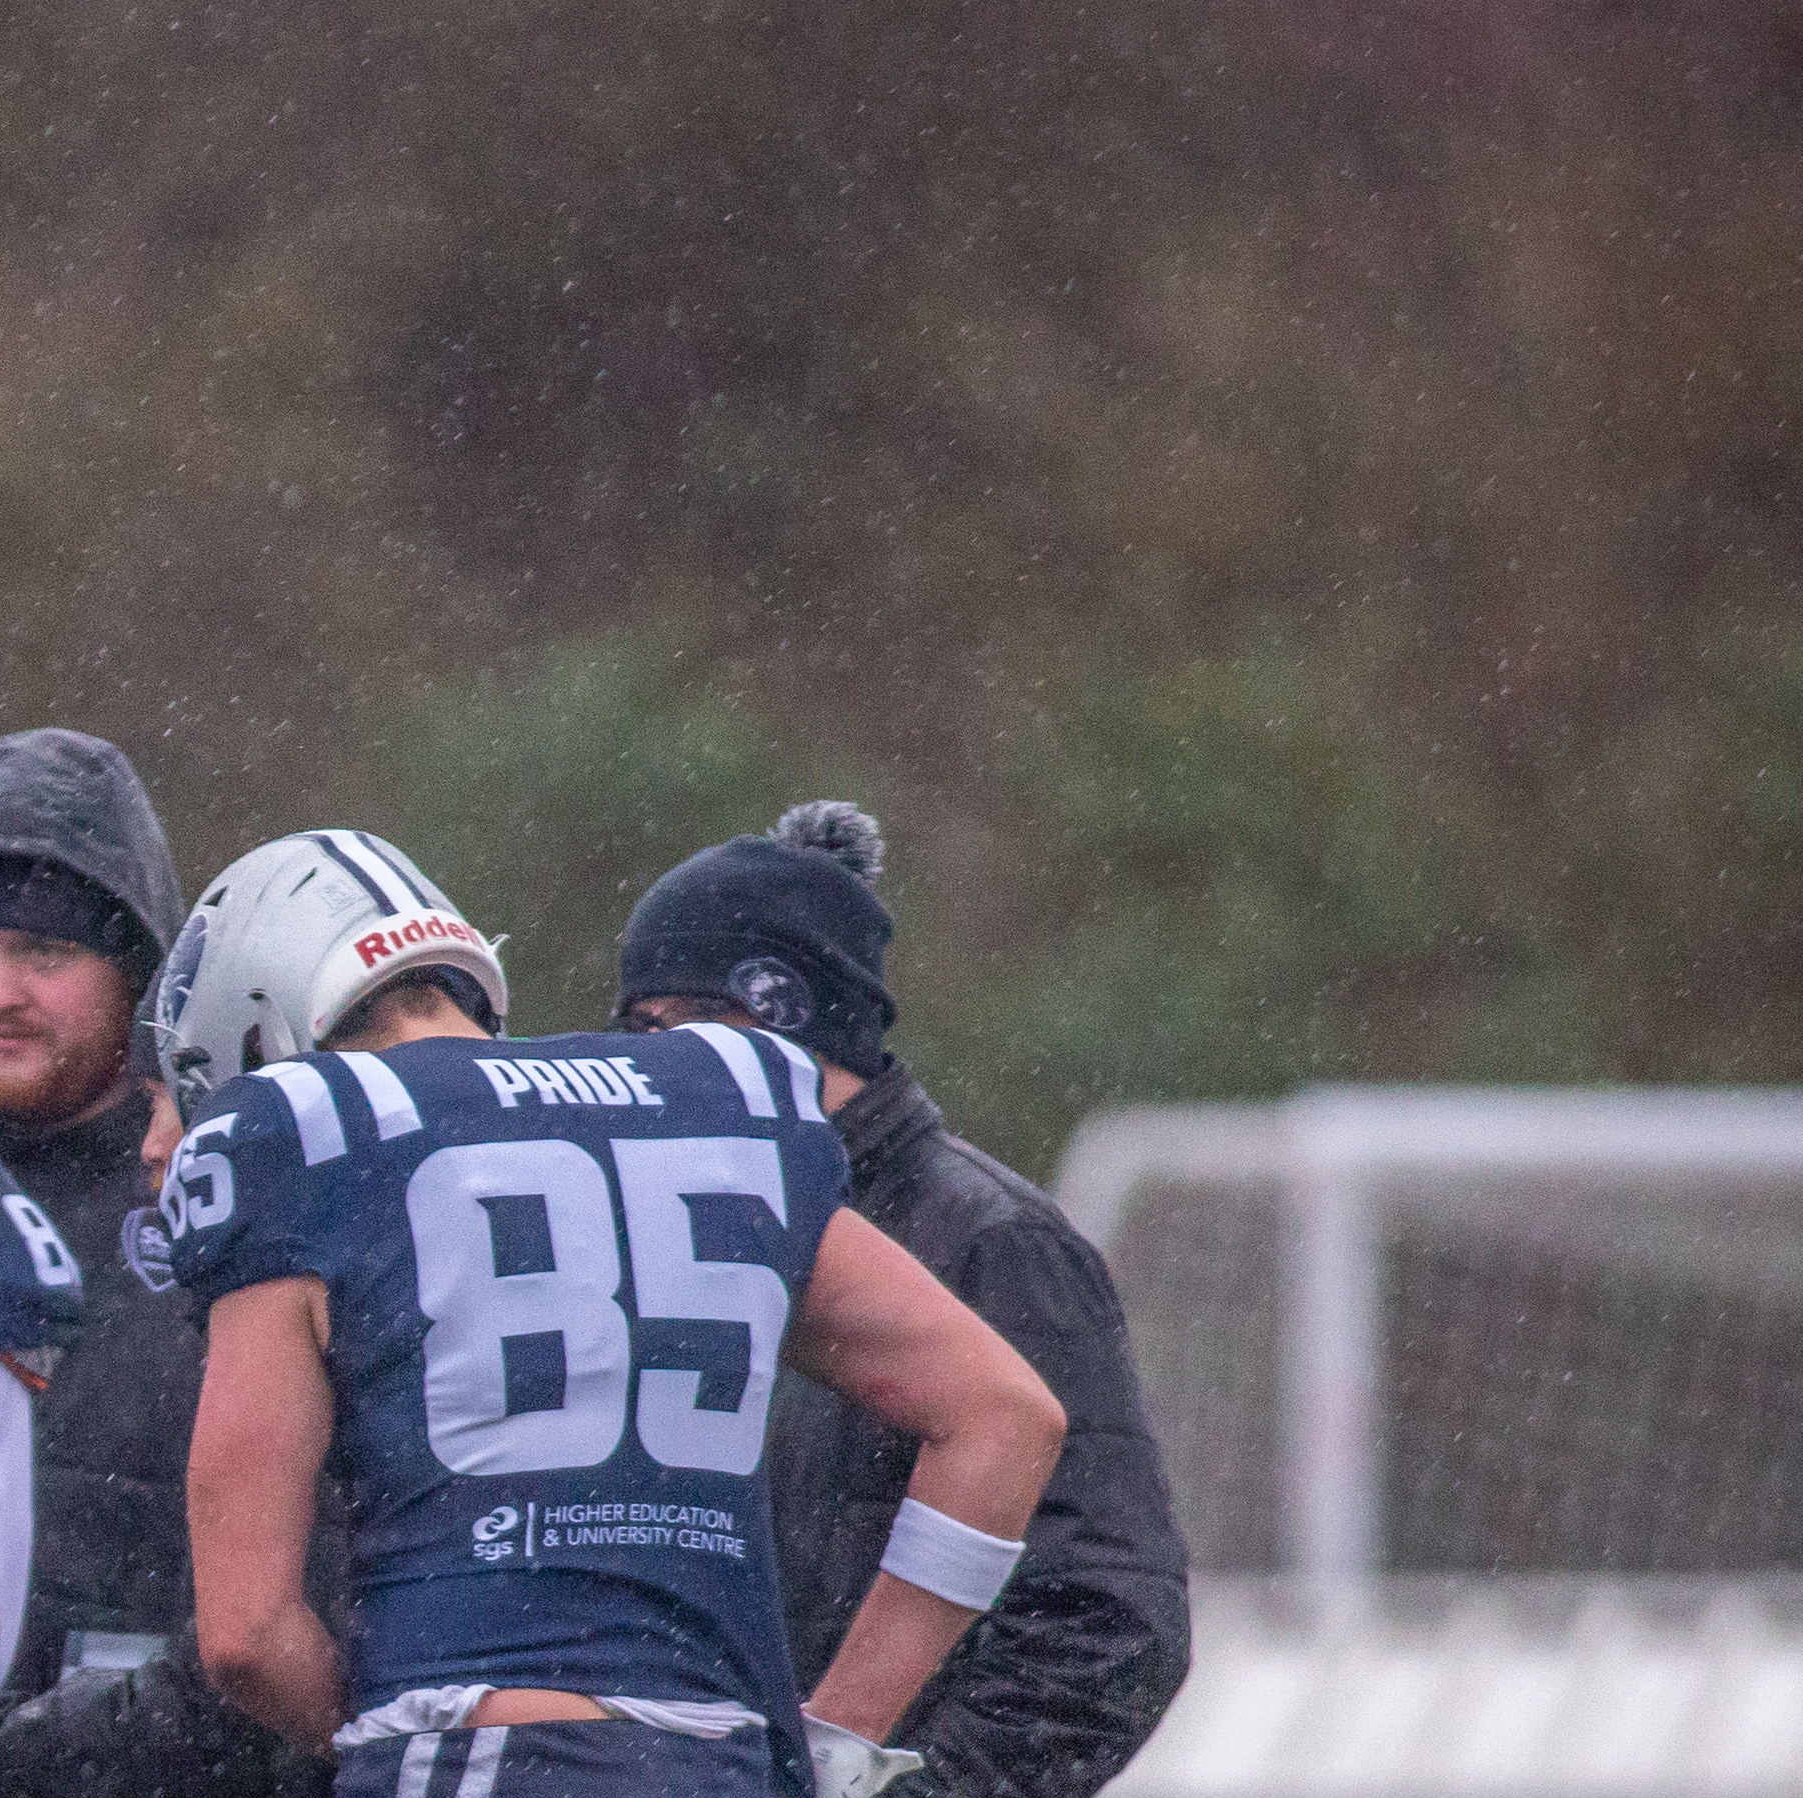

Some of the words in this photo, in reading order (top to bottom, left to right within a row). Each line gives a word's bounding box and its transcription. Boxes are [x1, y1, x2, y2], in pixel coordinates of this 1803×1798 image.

[473, 1056, 665, 1108] PRIDE
[405, 1136, 790, 1476] 85
[544, 1503, 625, 1524] HIGHER
[629, 1503, 733, 1531] EDUCATION
[473, 1541, 514, 1561] sgs
[543, 1528, 561, 1547] &
[566, 1526, 675, 1546] UNIVERSITY
[676, 1529, 746, 1558] CENTRE
